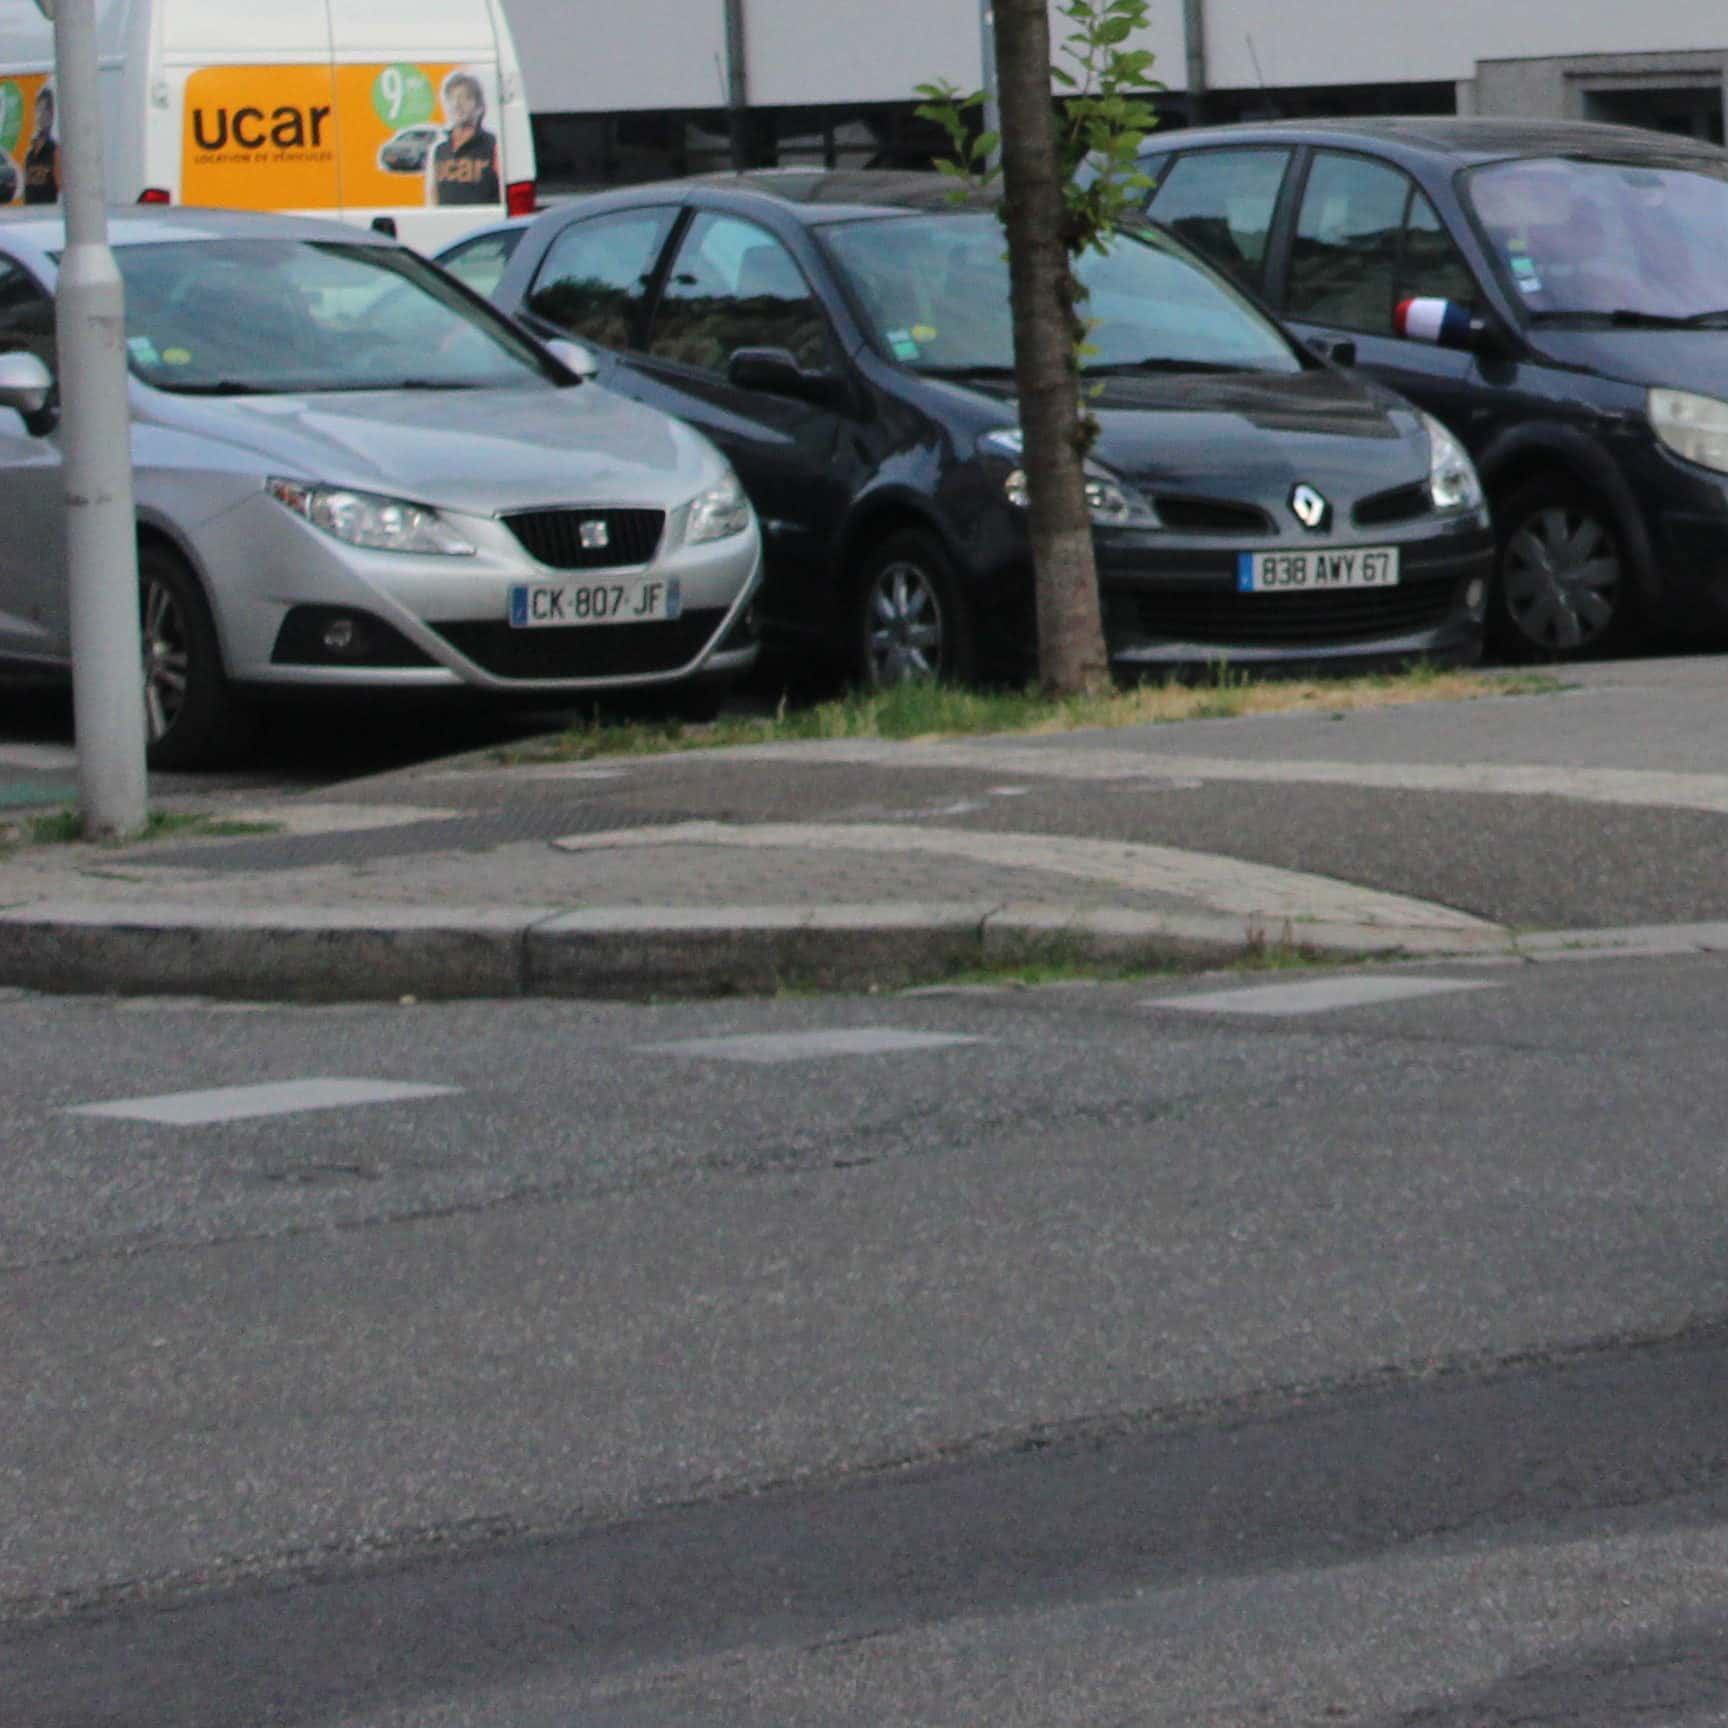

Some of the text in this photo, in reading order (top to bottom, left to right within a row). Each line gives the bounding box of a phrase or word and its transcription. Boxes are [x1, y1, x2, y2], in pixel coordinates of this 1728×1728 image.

[380, 67, 403, 120] 9
[192, 105, 331, 151] ucar
[1262, 552, 1390, 587] 838 AWY 67
